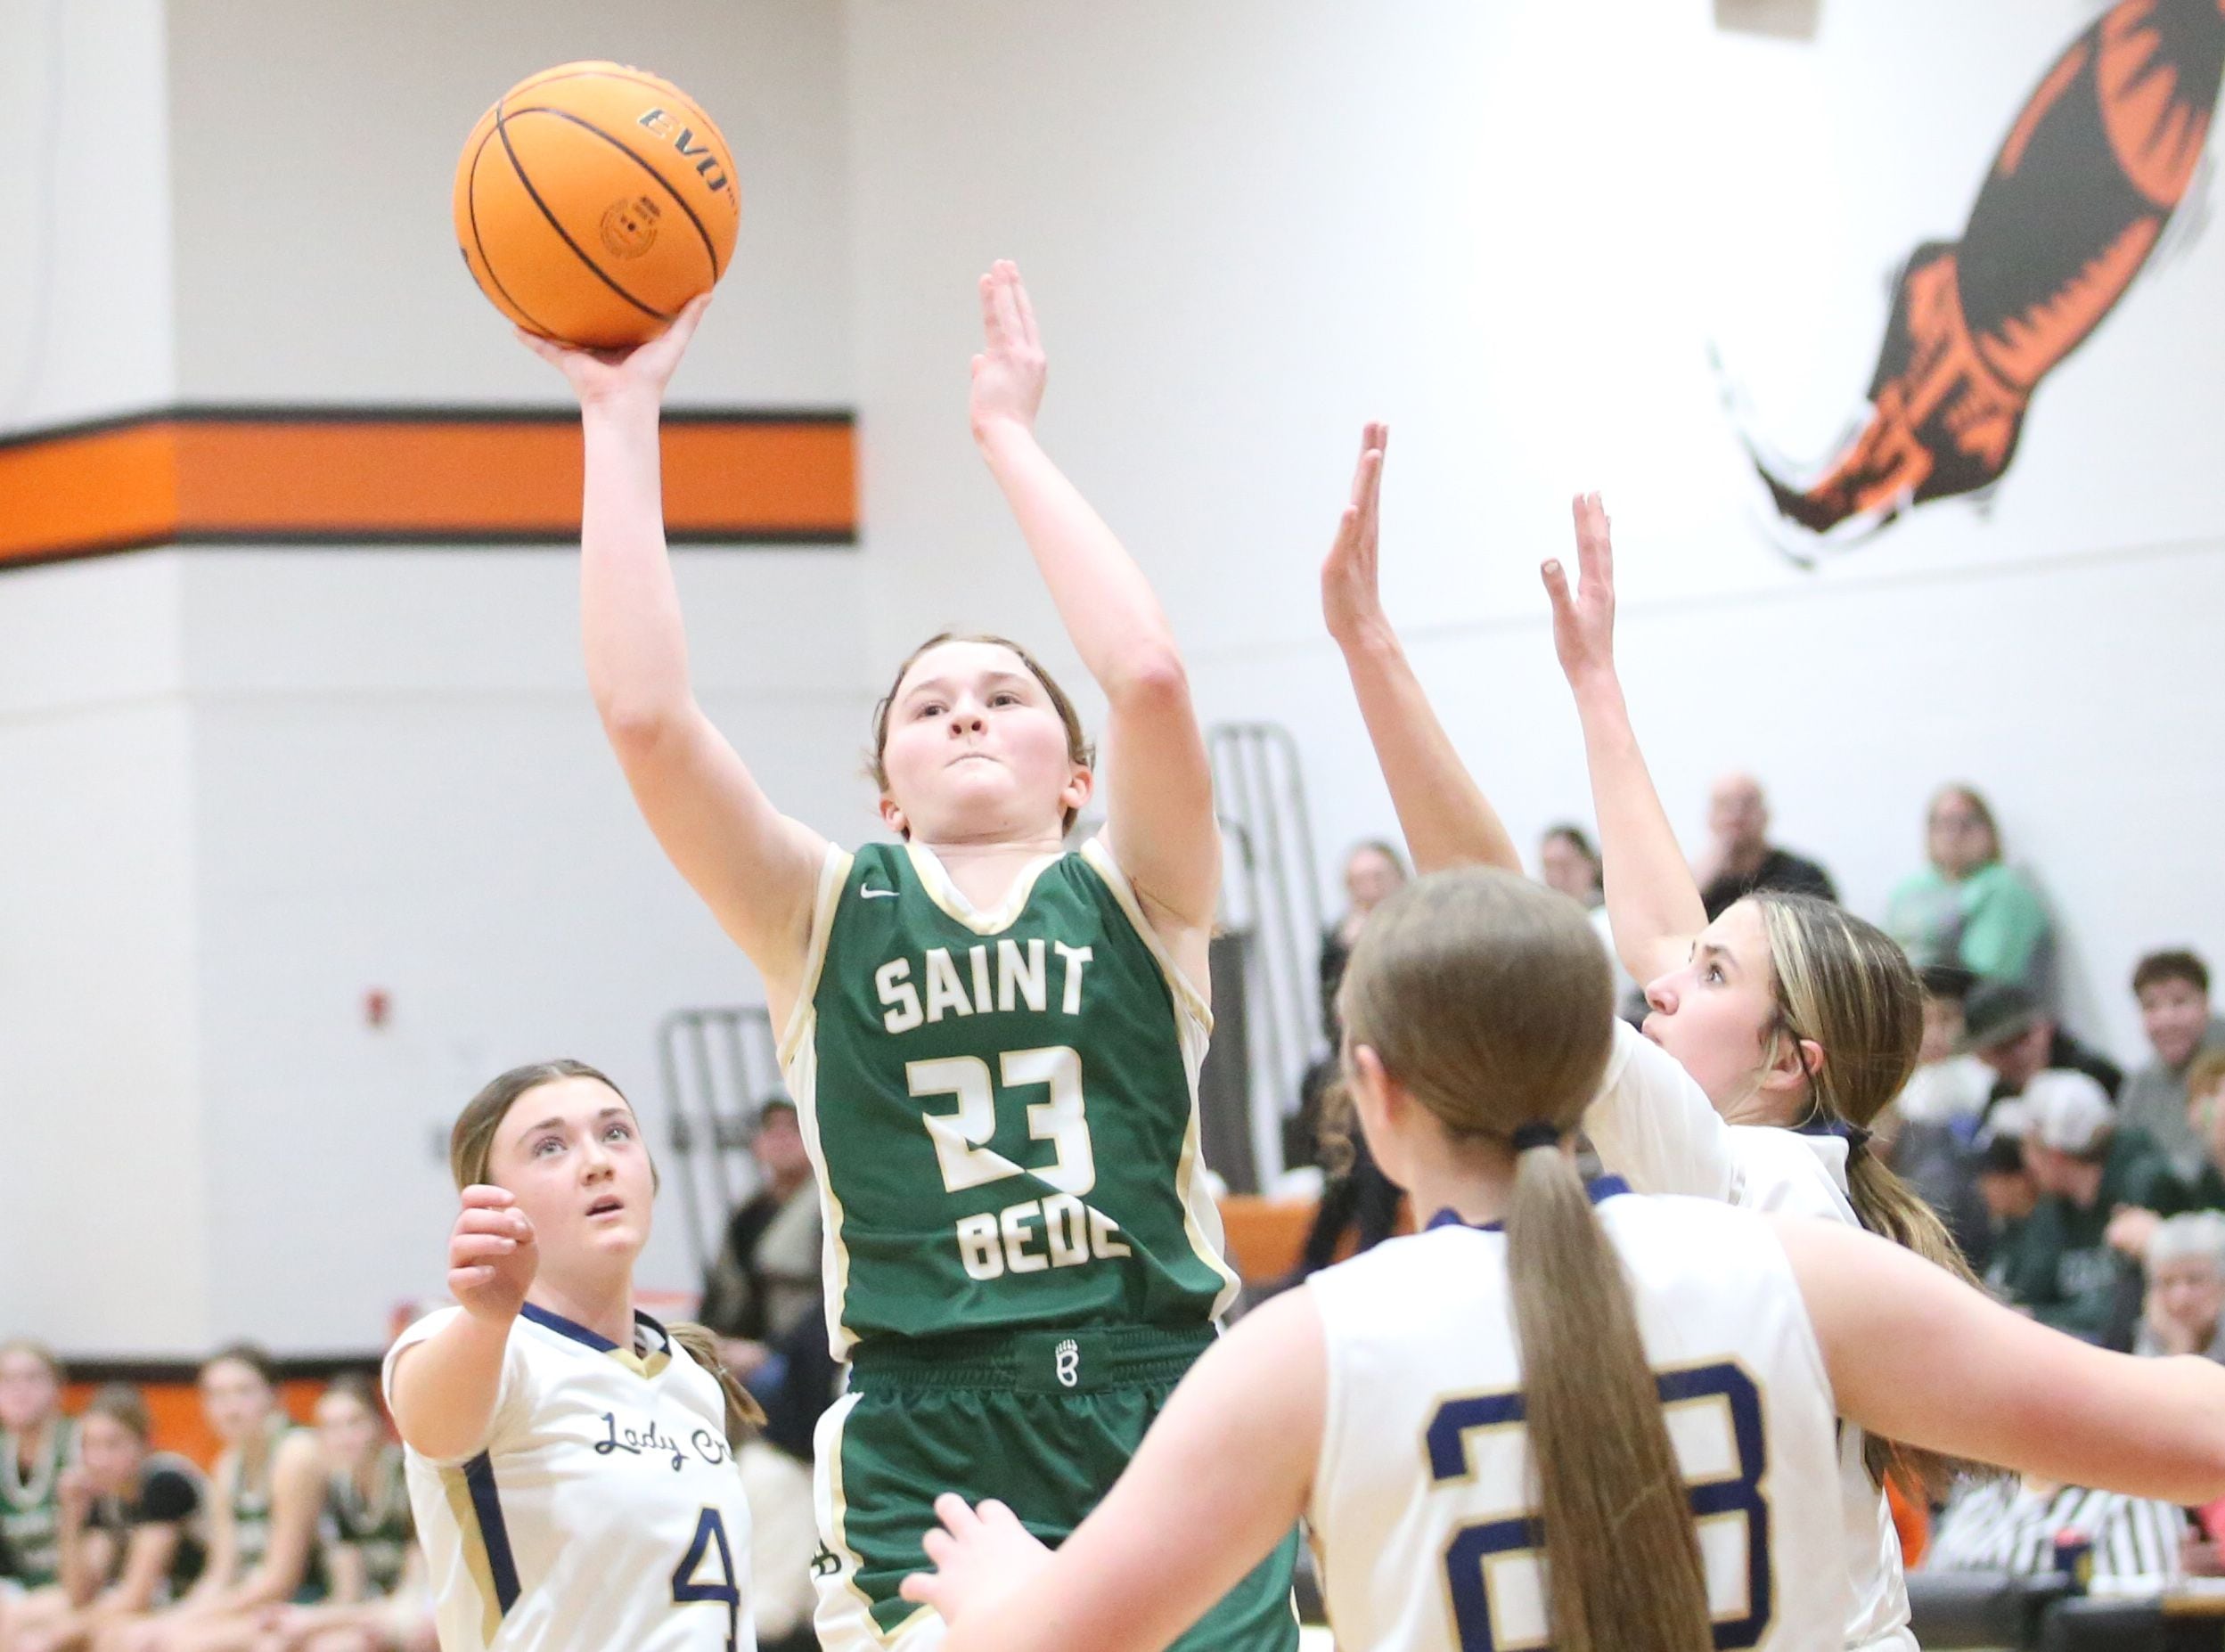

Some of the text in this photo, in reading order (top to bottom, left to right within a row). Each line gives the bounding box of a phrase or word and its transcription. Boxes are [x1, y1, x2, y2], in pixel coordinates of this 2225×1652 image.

[637, 108, 728, 192] EVO
[875, 938, 1093, 1034] SAINT
[904, 1045, 1096, 1197] 23
[956, 1193, 1132, 1280] BEDE
[595, 1411, 690, 1471] Lady
[671, 1505, 740, 1652] 4
